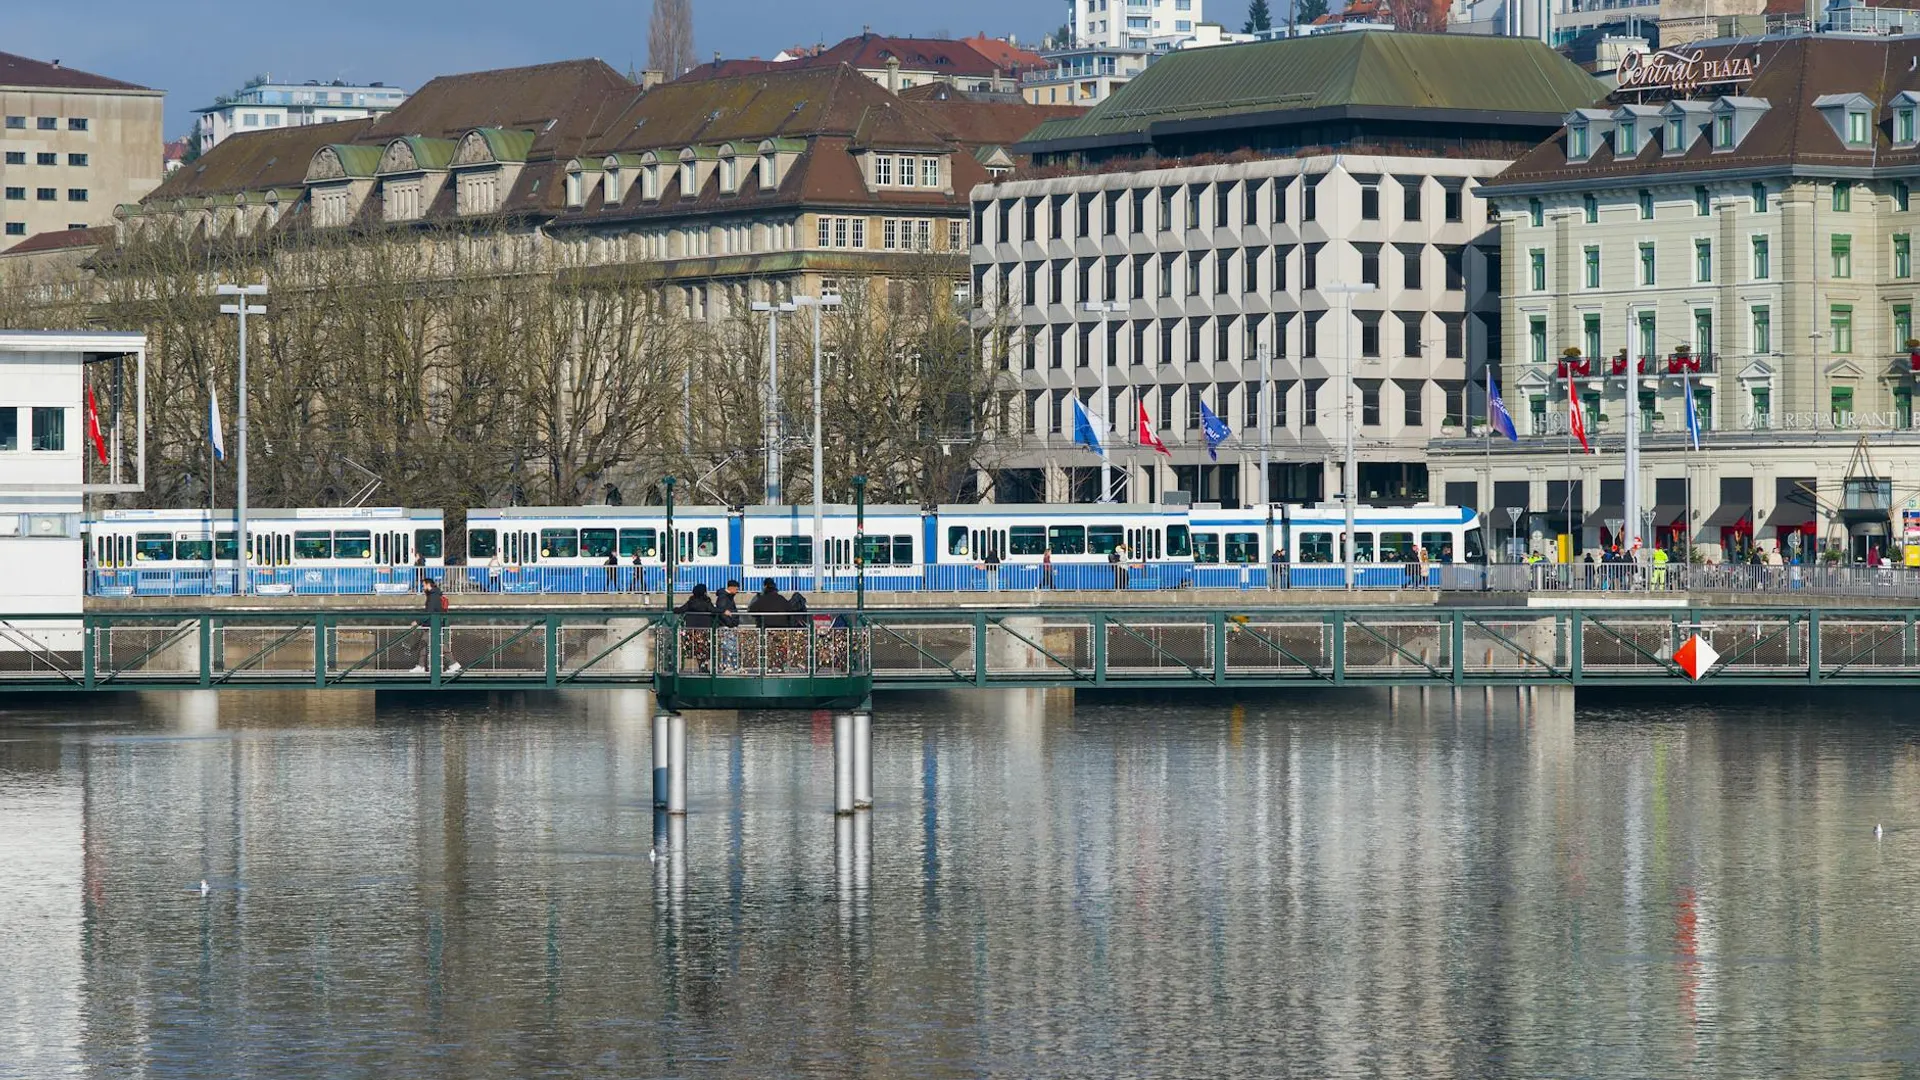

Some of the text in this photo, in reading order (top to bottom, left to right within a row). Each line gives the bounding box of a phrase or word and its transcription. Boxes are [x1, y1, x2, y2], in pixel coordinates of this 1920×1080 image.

[1616, 49, 1753, 86] Central PLAZA
[1786, 411, 1897, 428] RESTAURANT
